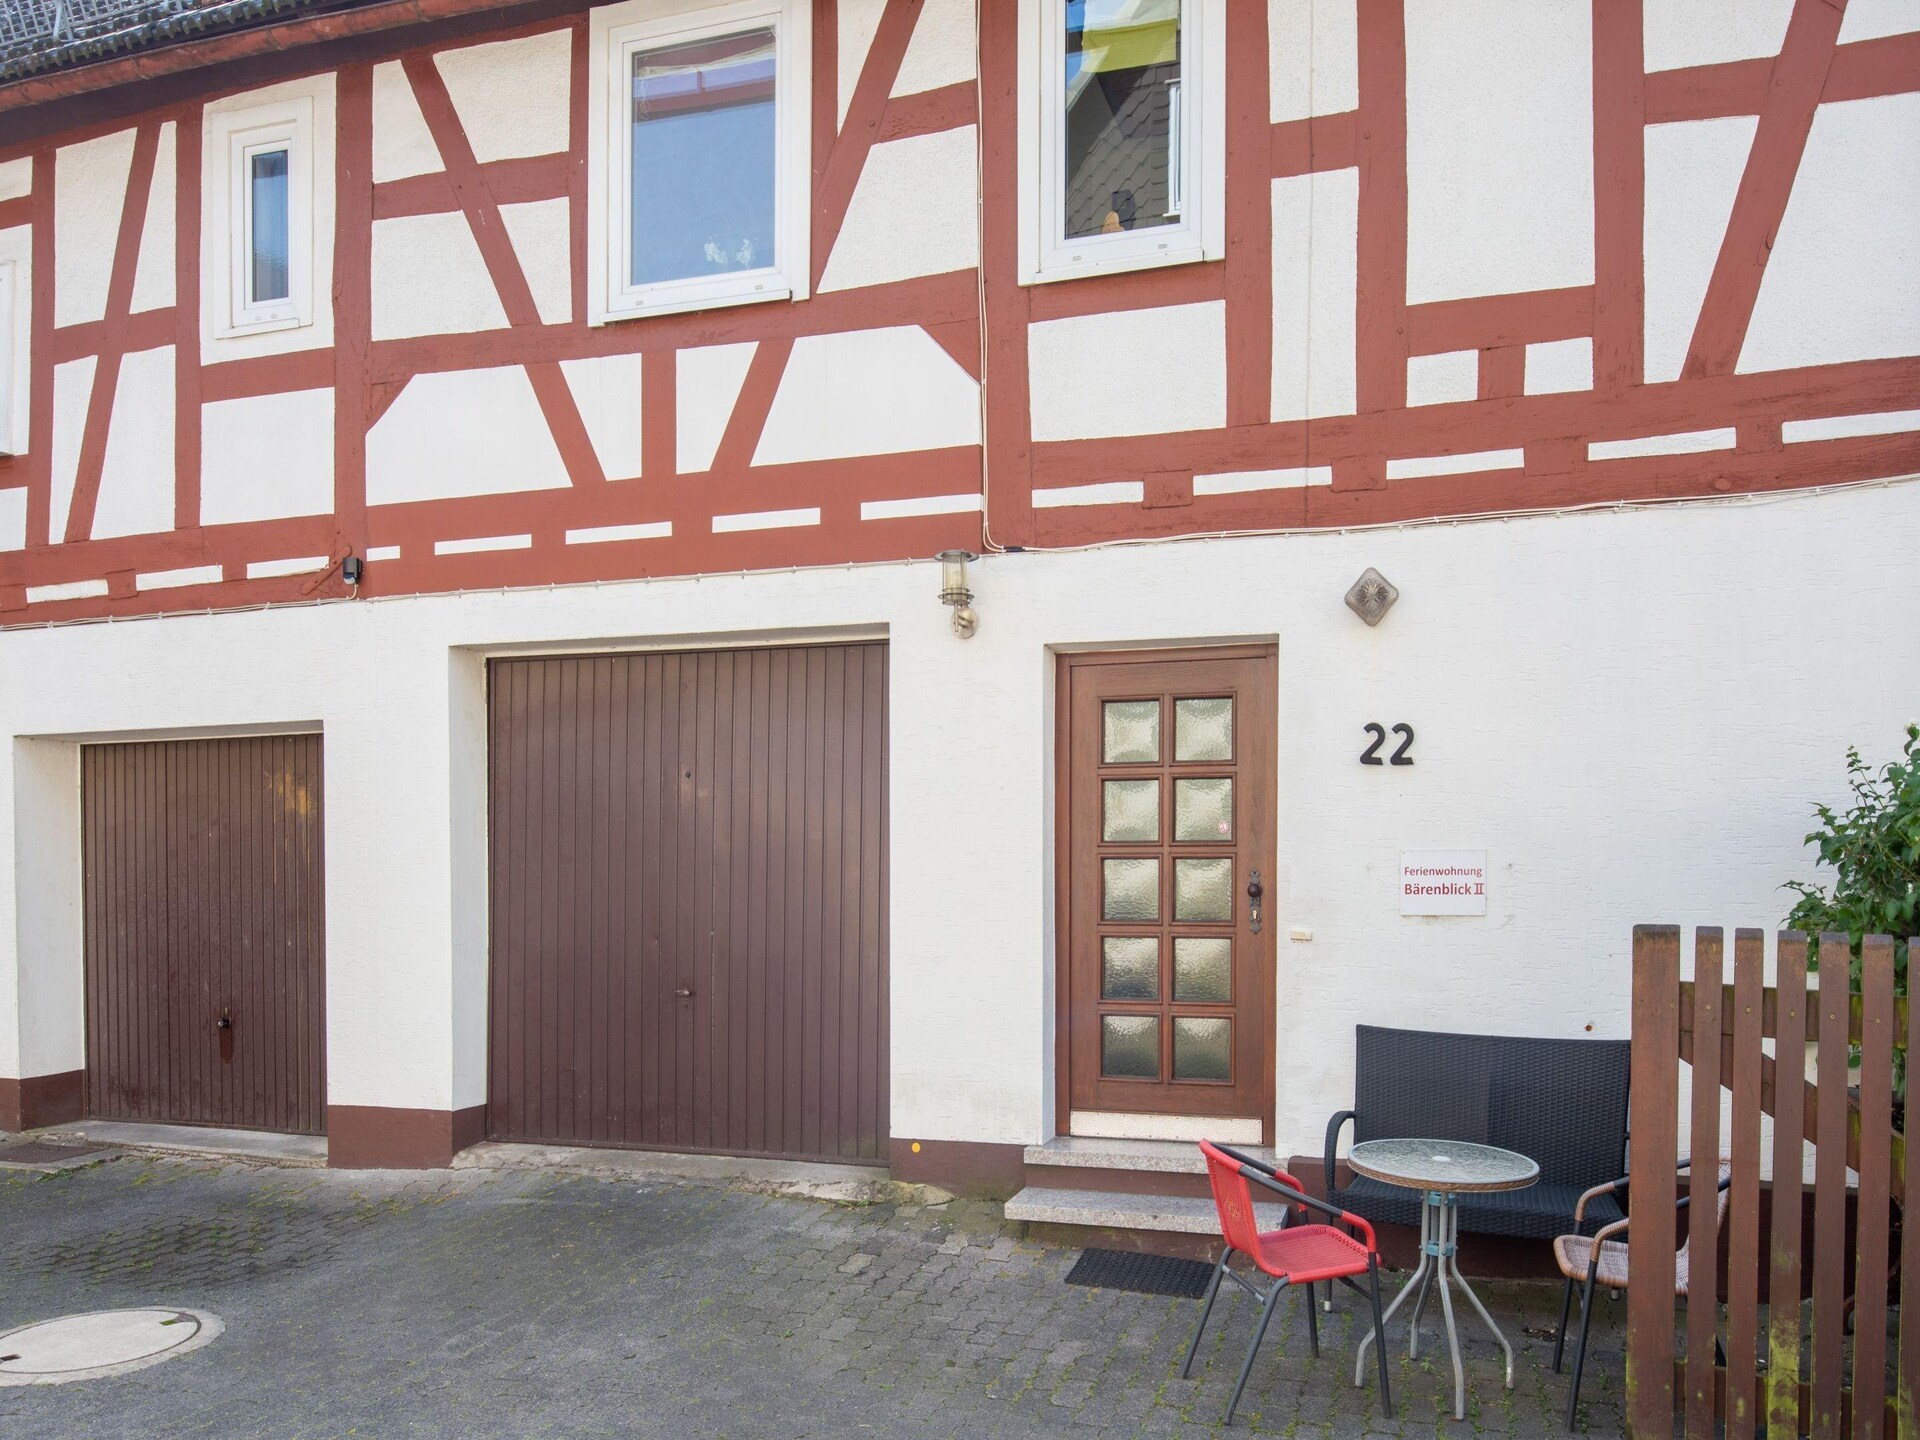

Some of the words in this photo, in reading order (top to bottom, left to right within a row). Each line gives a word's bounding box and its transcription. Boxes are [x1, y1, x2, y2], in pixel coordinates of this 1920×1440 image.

[1360, 722, 1415, 766] 22
[1404, 866, 1483, 878] Ferienwohnung
[1404, 883, 1472, 896] Bärenblick
[1474, 882, 1485, 895] II
